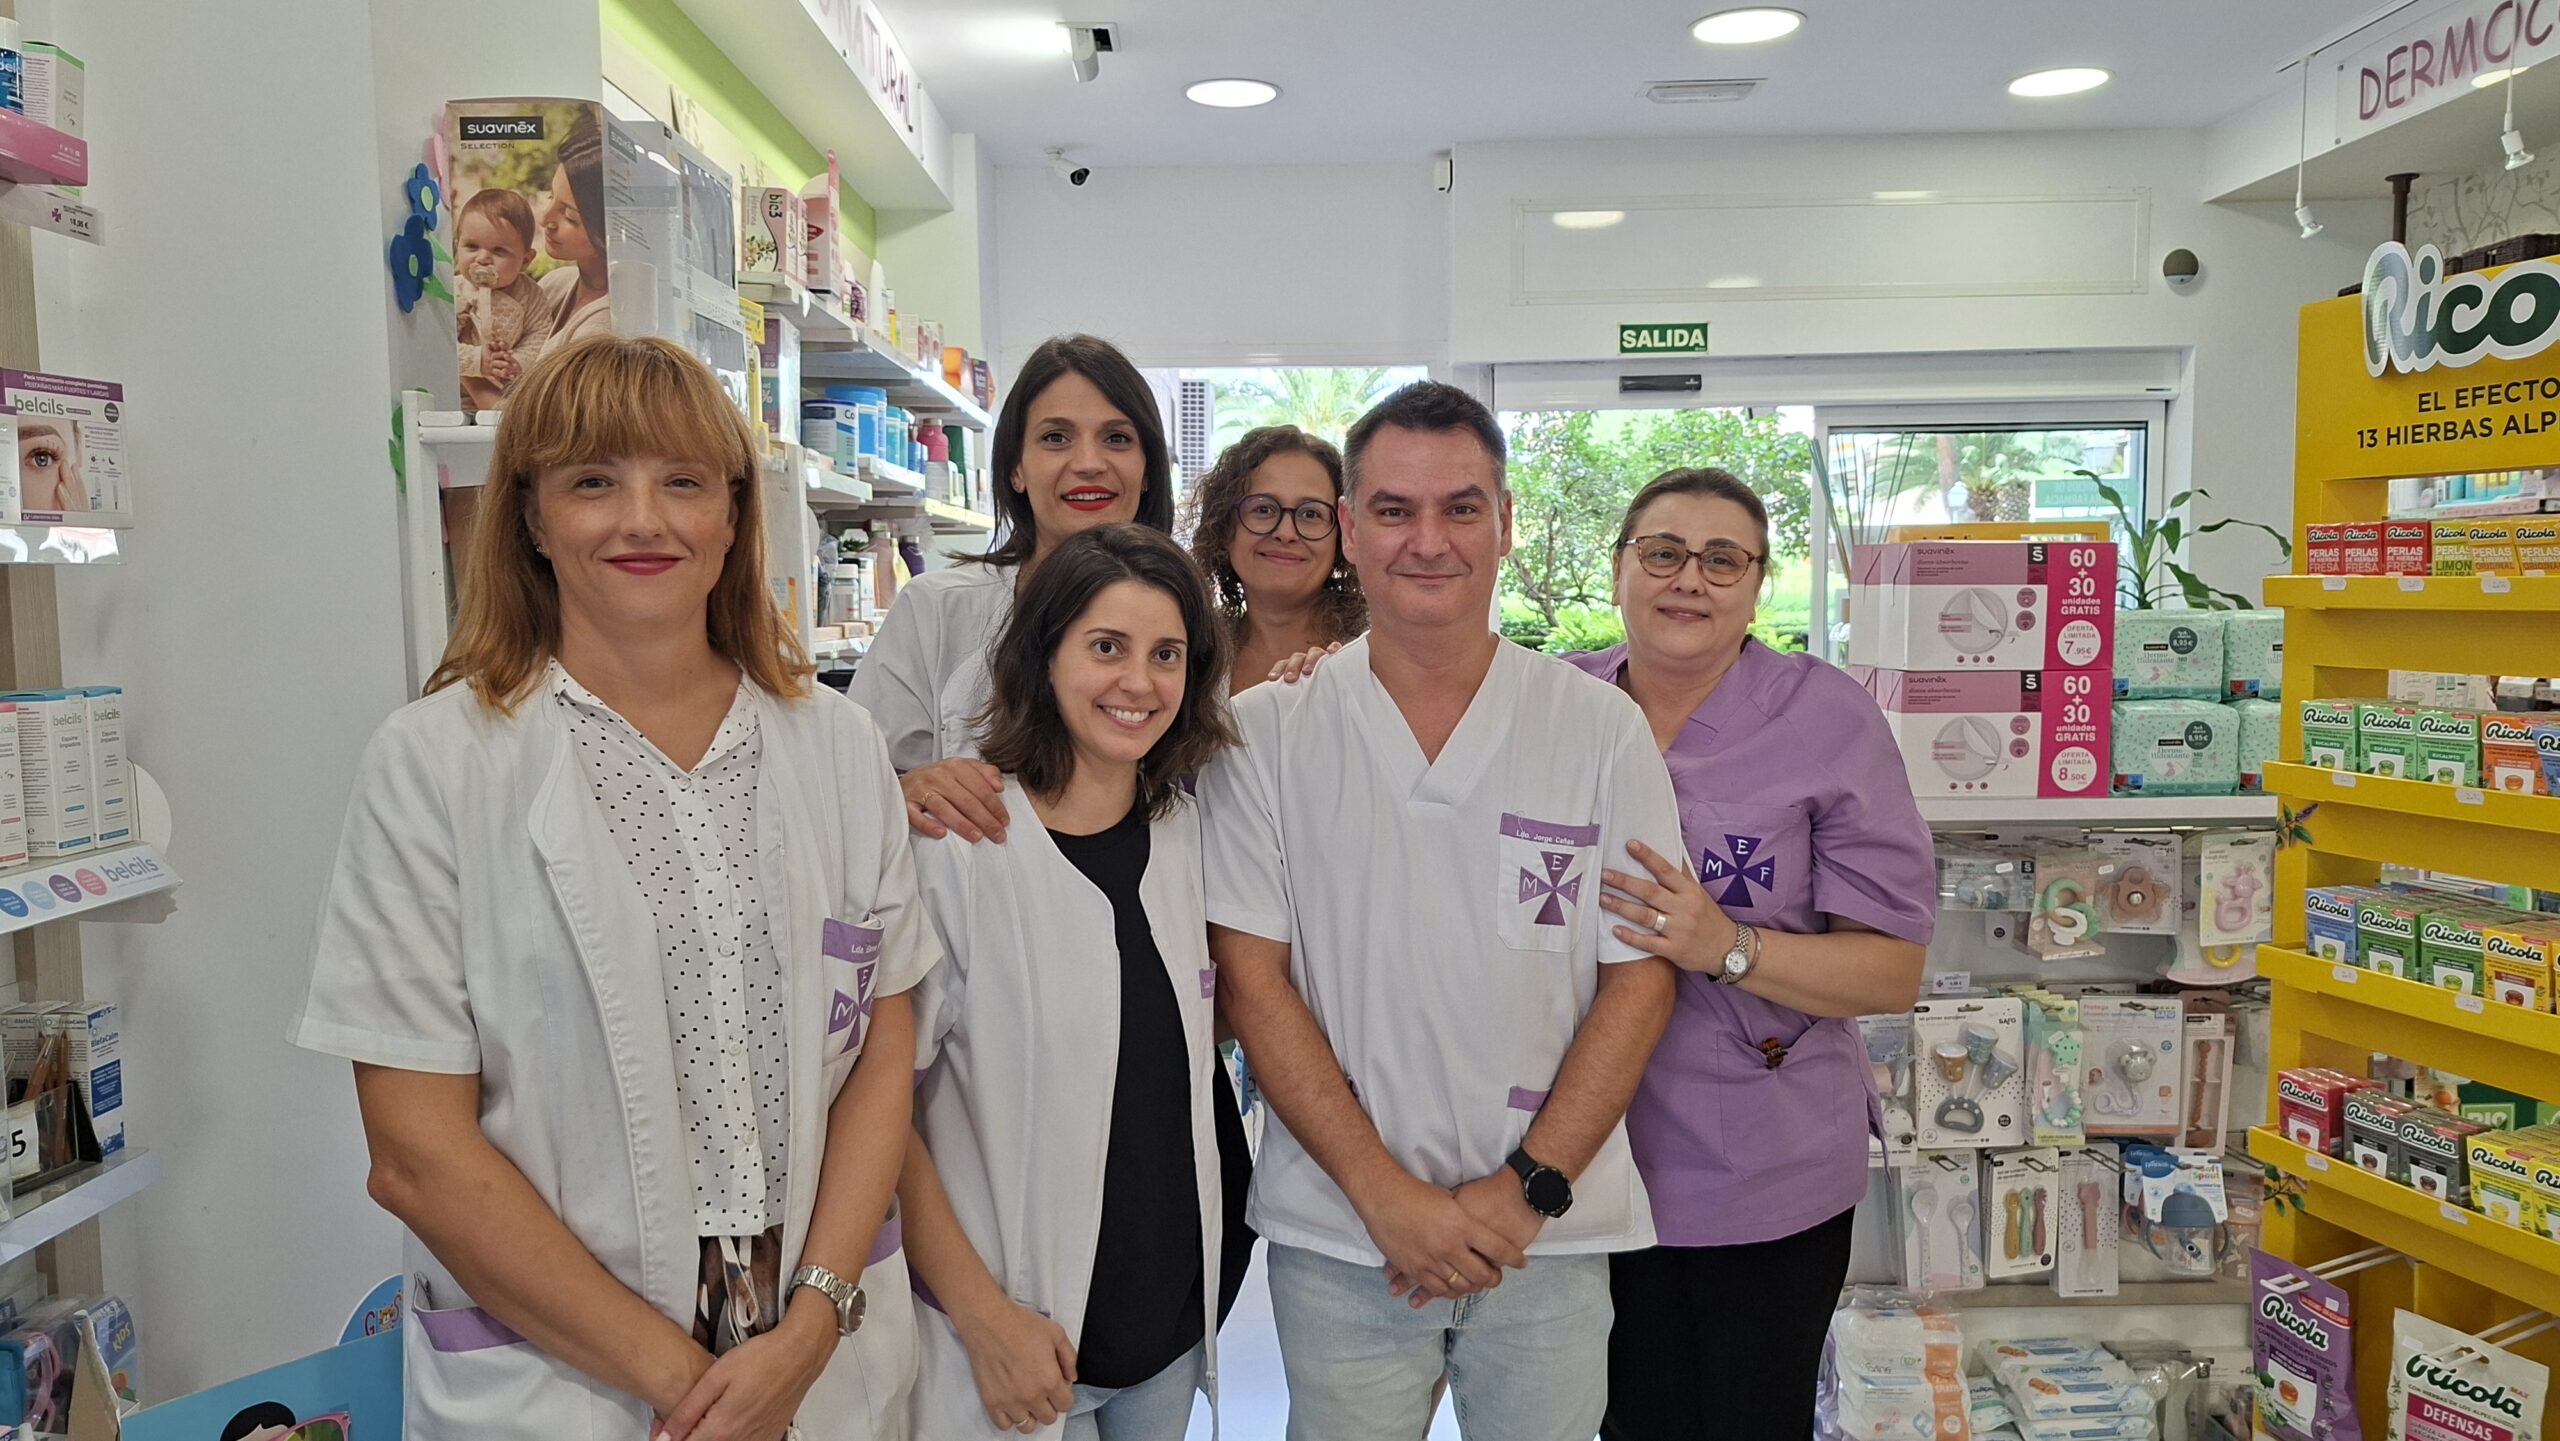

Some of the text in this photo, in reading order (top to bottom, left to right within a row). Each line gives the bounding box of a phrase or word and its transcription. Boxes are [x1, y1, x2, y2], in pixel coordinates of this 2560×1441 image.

[2359, 0, 2560, 120] DERMOC
[1622, 328, 1705, 348] SALIDA
[2418, 377, 2560, 413] EL EFECTO
[14, 394, 65, 416] belcils
[2357, 411, 2560, 448] 13 HIERBAS ALP
[2309, 531, 2339, 541] Ricola
[2345, 529, 2377, 540] Ricola
[2387, 527, 2422, 539] Ricola
[2434, 527, 2466, 538] Ricol
[2469, 528, 2508, 539] Ricola
[2515, 528, 2556, 539] Ricola
[2070, 549, 2096, 567] 60
[2309, 548, 2339, 558] PERLAS
[2345, 548, 2378, 558] PERLAS
[2387, 546, 2423, 556] PERLAS
[2473, 547, 2512, 557] PERLAS
[2309, 563, 2340, 572] FRESA
[2345, 563, 2379, 572] FRESA
[2386, 562, 2423, 572] FRESA
[2069, 577, 2095, 596] 30
[2062, 597, 2101, 605] unidades
[2061, 606, 2100, 615] GRATIS
[2064, 675, 2091, 694] 60
[53, 713, 82, 726] belcils
[93, 708, 120, 721] belcils
[2063, 705, 2090, 723] 30
[2304, 709, 2349, 725] Ricola
[2363, 713, 2411, 729] Ricola
[2056, 724, 2096, 732] unidades
[2420, 717, 2470, 735] Ricola
[2486, 723, 2534, 740] Ricol
[2055, 733, 2096, 742] GRATIS
[1736, 839, 1749, 855] E
[99, 856, 159, 882] belcils
[1551, 855, 1563, 871] E
[1705, 858, 1722, 877] M
[1760, 867, 1771, 882] F
[1523, 877, 1538, 895] M
[1570, 882, 1578, 897] F
[2308, 896, 2349, 917] Ricola
[2361, 910, 2409, 932] Ricola
[2425, 924, 2481, 946] Ricola
[2488, 937, 2542, 961] Ricola
[2281, 1081, 2323, 1105] Ricola
[2347, 1104, 2394, 1130] Ricola
[11, 1129, 27, 1158] 5
[2403, 1125, 2454, 1152] Ricola
[2472, 1148, 2527, 1175] Ricola
[2263, 1296, 2327, 1349] Ricola
[2406, 1354, 2521, 1419] Ricola
[2423, 1403, 2493, 1441] DEFENSAS
